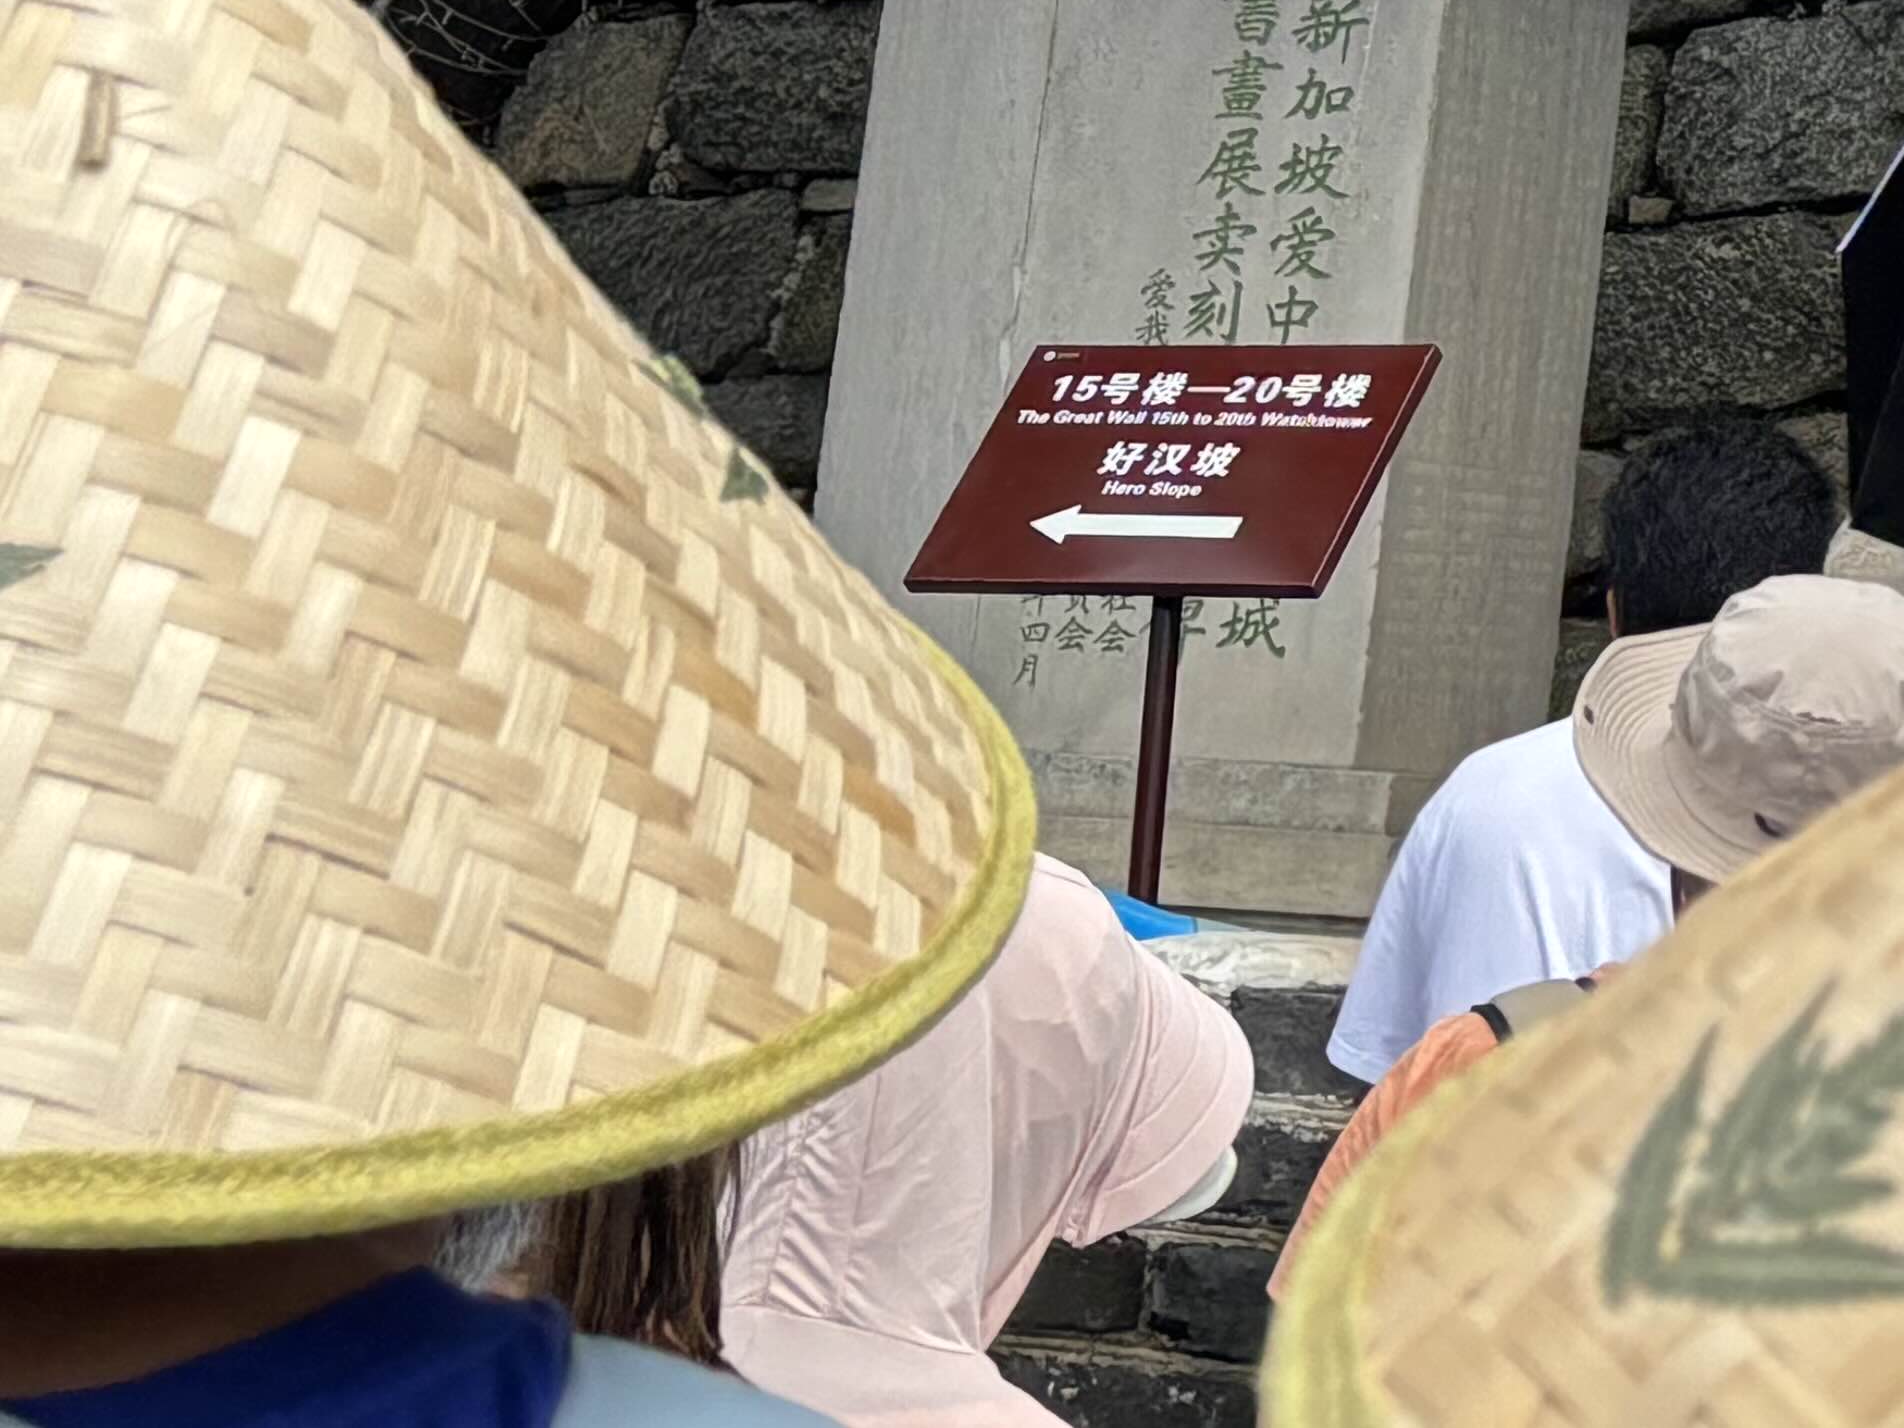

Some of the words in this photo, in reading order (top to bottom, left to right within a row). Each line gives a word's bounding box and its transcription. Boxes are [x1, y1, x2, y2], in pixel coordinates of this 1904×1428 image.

[1017, 409, 1050, 425] The
[1053, 409, 1102, 426] Great
[1107, 409, 1148, 426] Wall
[1151, 410, 1188, 426] 15th
[1193, 411, 1212, 426] to
[1213, 411, 1255, 426] 20th
[1096, 440, 1241, 479] 好汉坡
[1102, 480, 1146, 496] Hero
[1150, 480, 1202, 498] Slope
